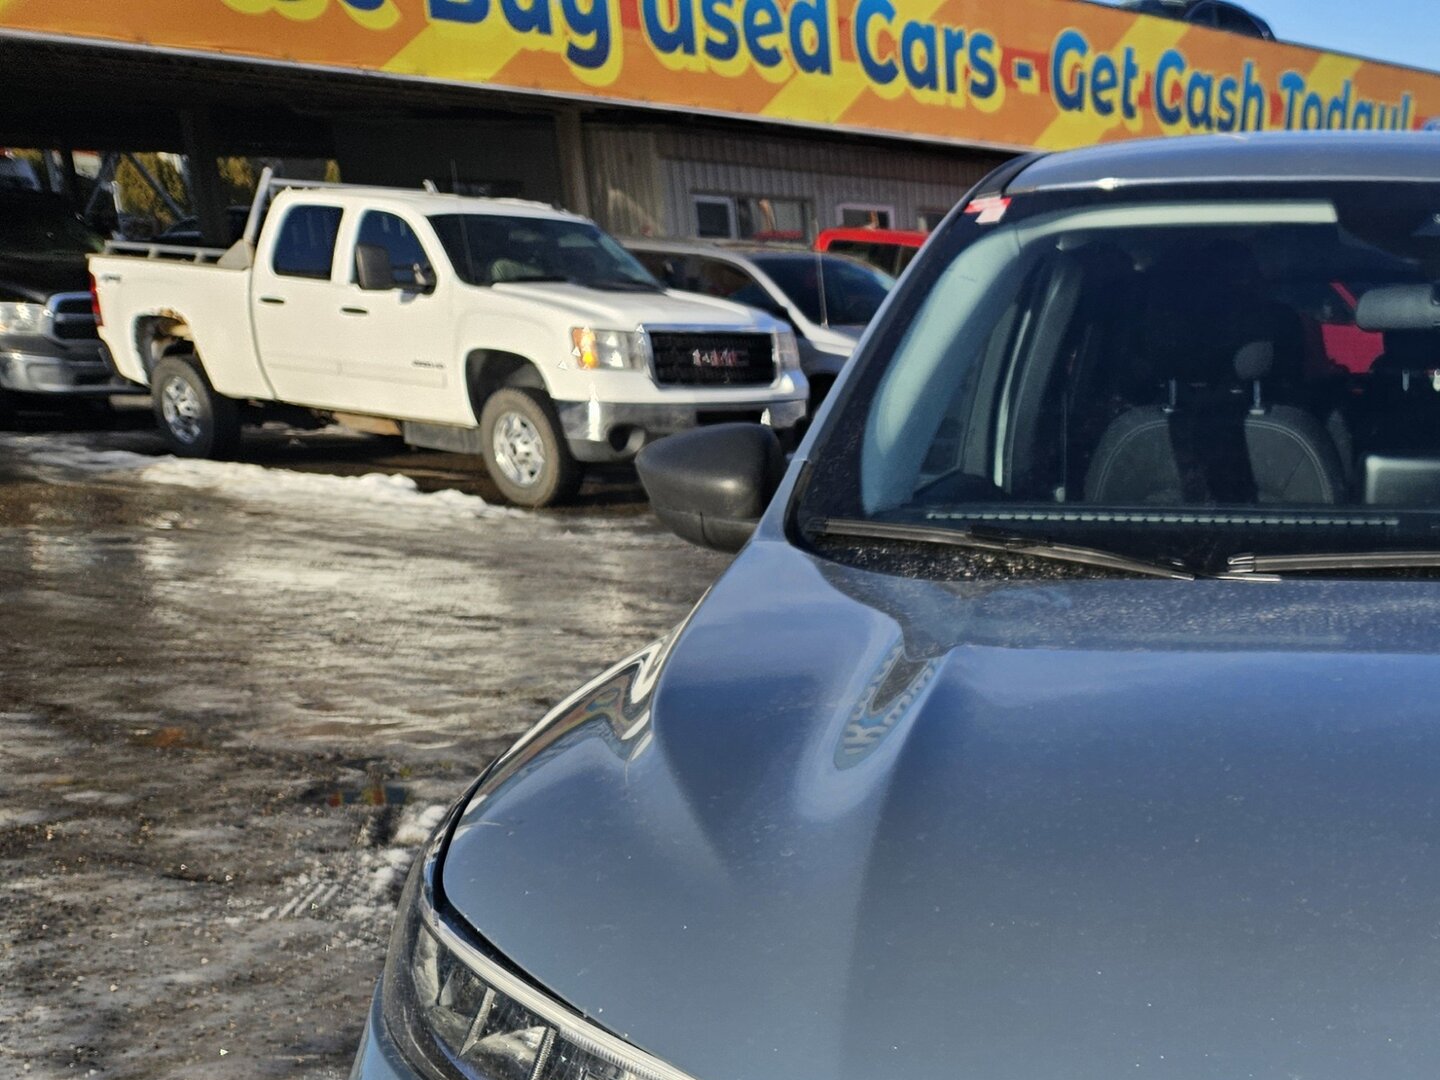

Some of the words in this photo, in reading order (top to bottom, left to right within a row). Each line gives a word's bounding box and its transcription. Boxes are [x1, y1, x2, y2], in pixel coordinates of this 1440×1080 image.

[643, 0, 832, 75] used
[854, 0, 999, 100] Cars
[1051, 30, 1138, 121] Get
[1155, 49, 1265, 132] Cash
